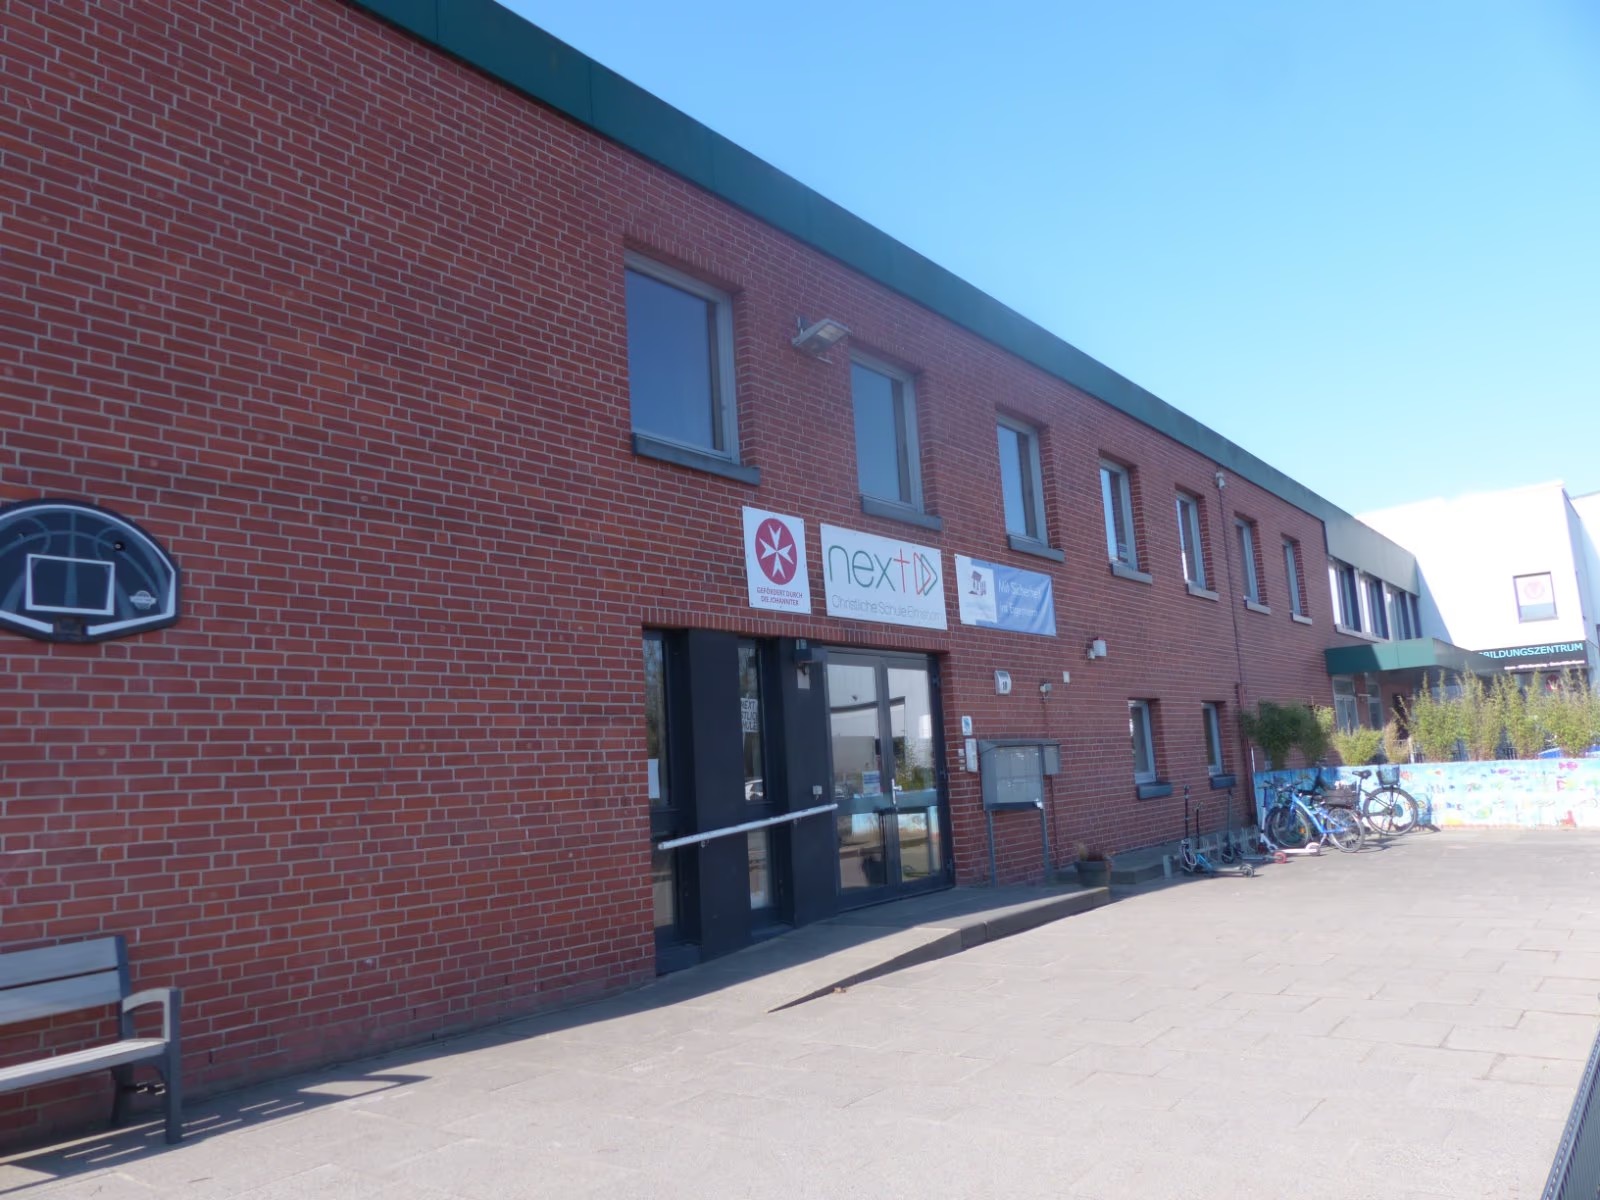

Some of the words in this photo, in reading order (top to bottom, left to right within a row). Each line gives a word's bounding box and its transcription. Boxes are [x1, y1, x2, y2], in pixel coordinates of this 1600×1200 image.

[756, 586, 785, 597] GEFÖRDERT
[785, 590, 803, 599] DURCH
[831, 594, 878, 614] Christliche
[879, 601, 907, 617] Schule
